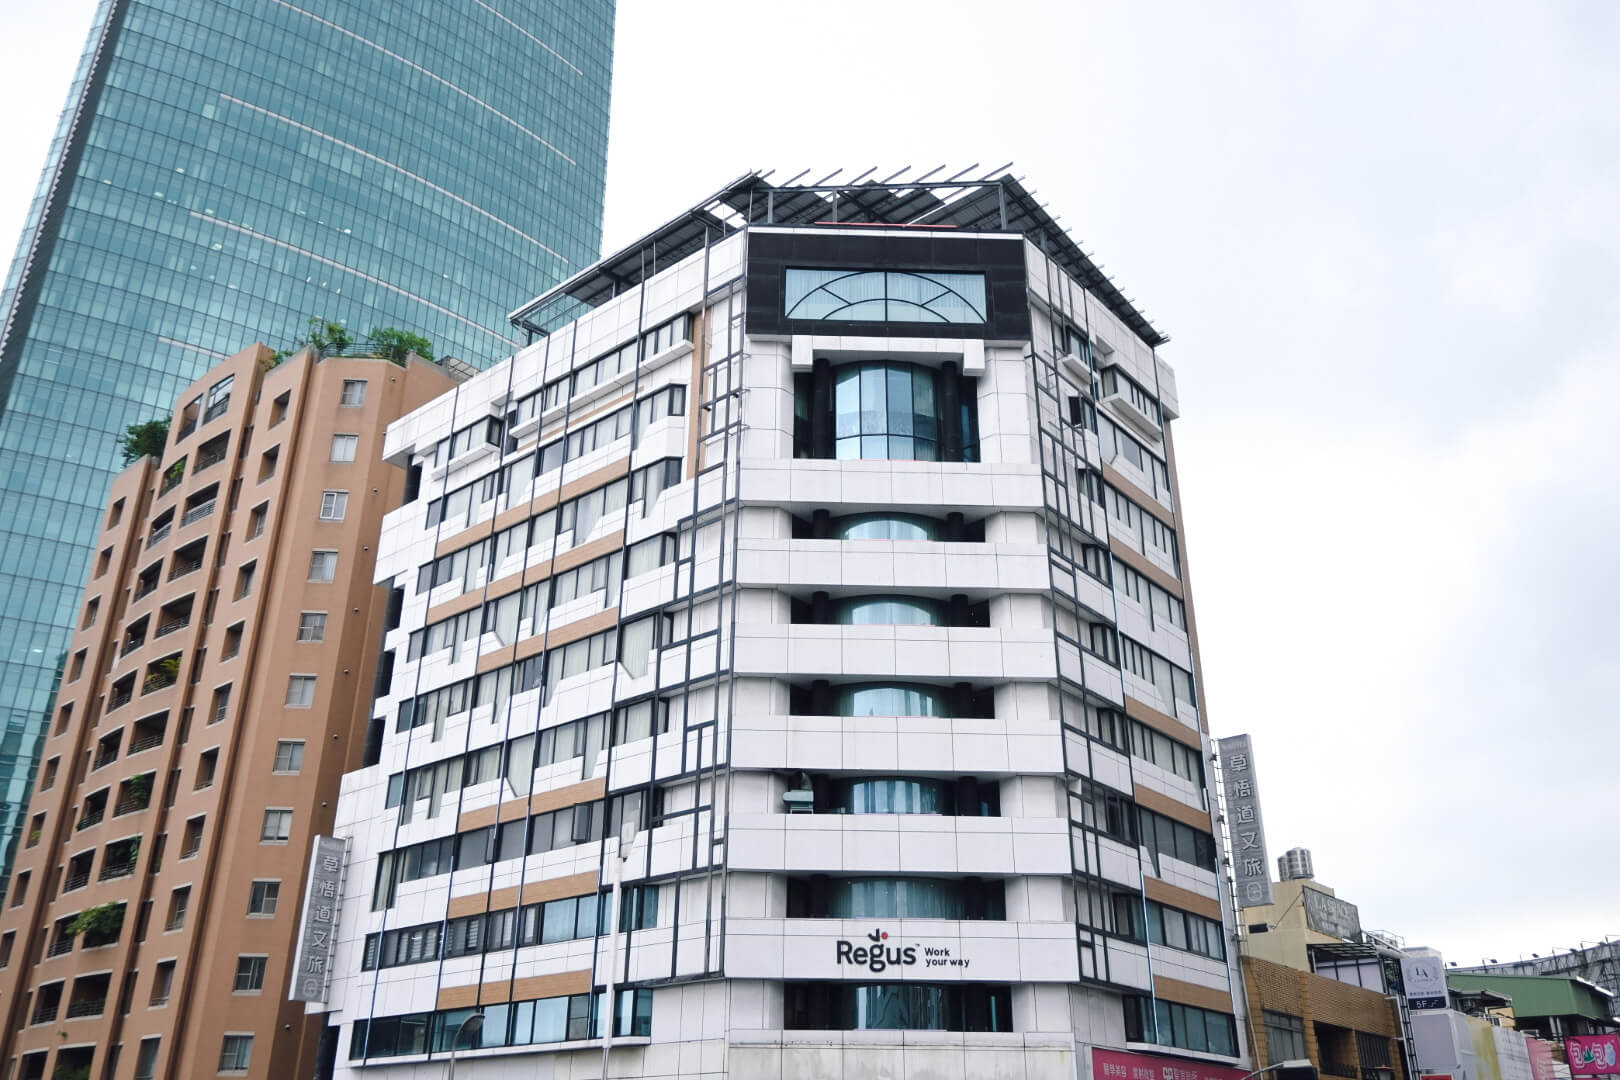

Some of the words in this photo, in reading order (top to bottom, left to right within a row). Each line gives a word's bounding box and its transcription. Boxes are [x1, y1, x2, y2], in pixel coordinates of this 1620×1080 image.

[1230, 754, 1264, 877] 草悟道文旅
[306, 855, 339, 974] 草悟道文旅
[836, 940, 917, 973] Regus
[924, 947, 950, 957] Work
[925, 958, 947, 968] your
[950, 958, 970, 969] way
[1416, 1000, 1427, 1009] 5F
